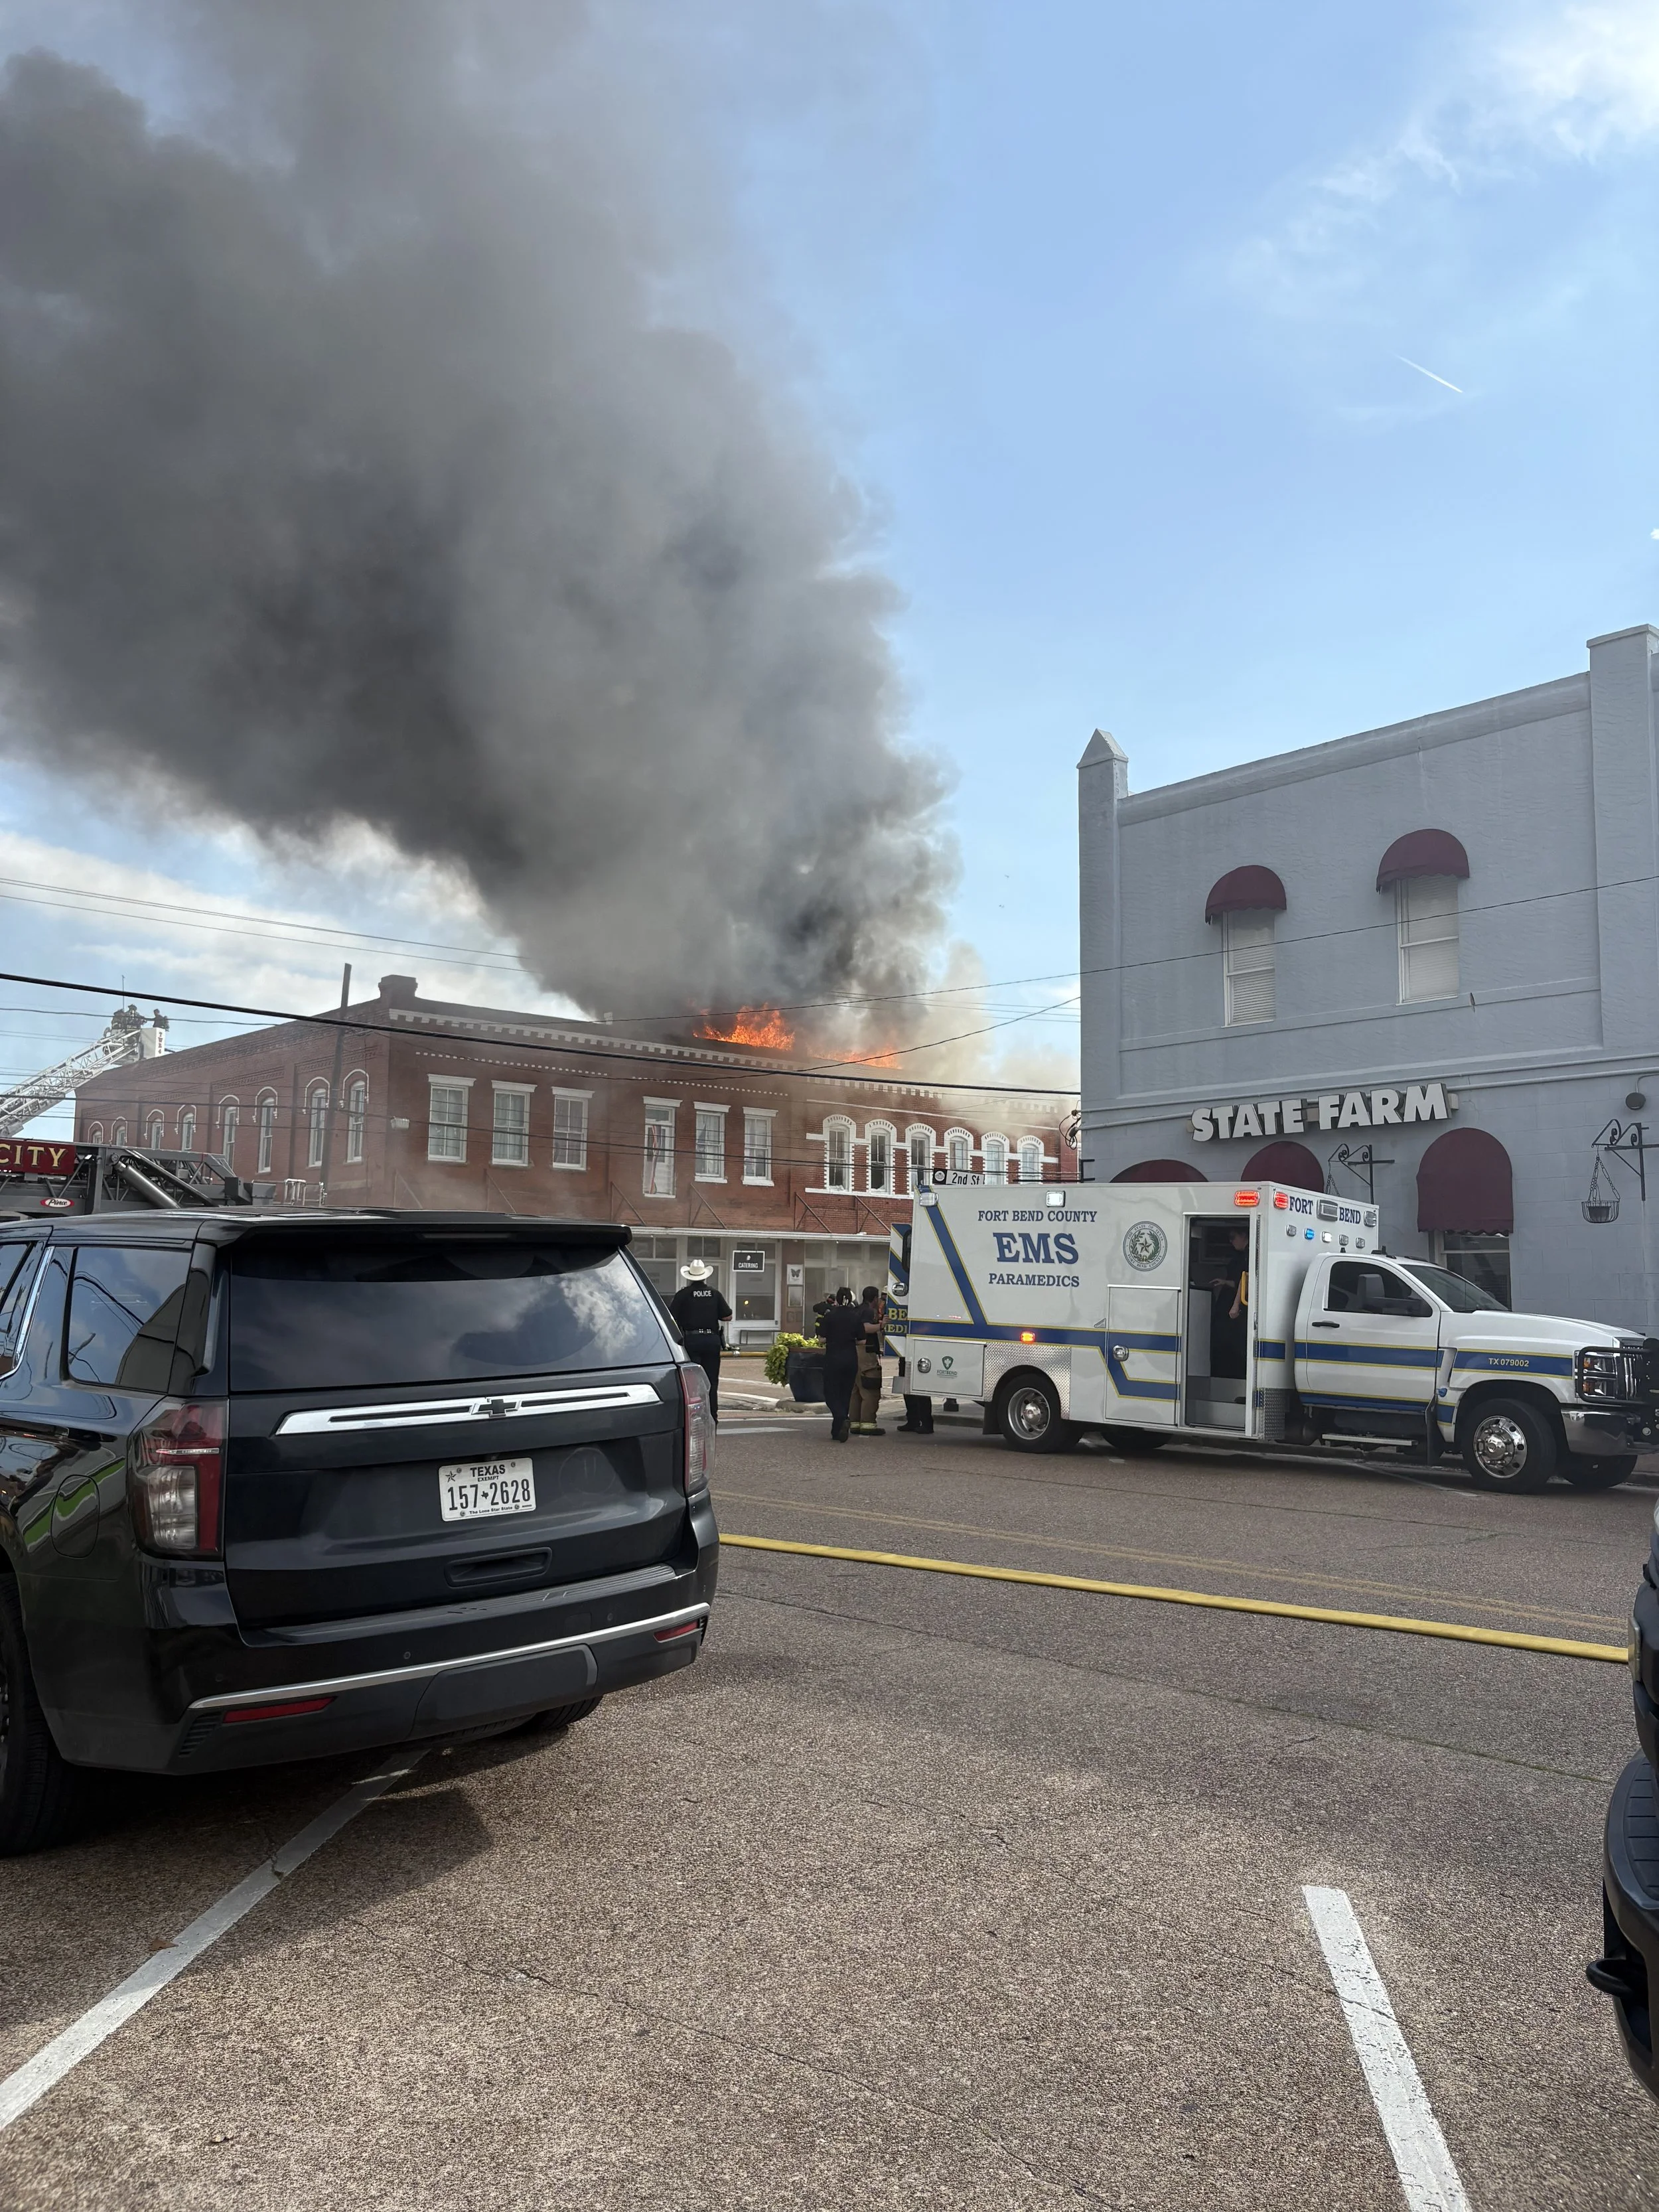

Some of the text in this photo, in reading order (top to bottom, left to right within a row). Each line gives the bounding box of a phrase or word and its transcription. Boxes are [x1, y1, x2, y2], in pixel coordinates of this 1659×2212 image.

[1191, 1082, 1451, 1142] STATE FARM
[0, 1143, 66, 1167] CITY
[952, 1172, 968, 1185] 2nd
[971, 1175, 979, 1185] St
[978, 1211, 1098, 1222] FORT BEND COUNTY
[1289, 1196, 1361, 1225] FORT BEND
[993, 1232, 1079, 1264] EMS
[989, 1273, 1080, 1288] PARAMEDICS
[1500, 1359, 1529, 1367] 079002
[470, 1464, 506, 1477] TEXAS
